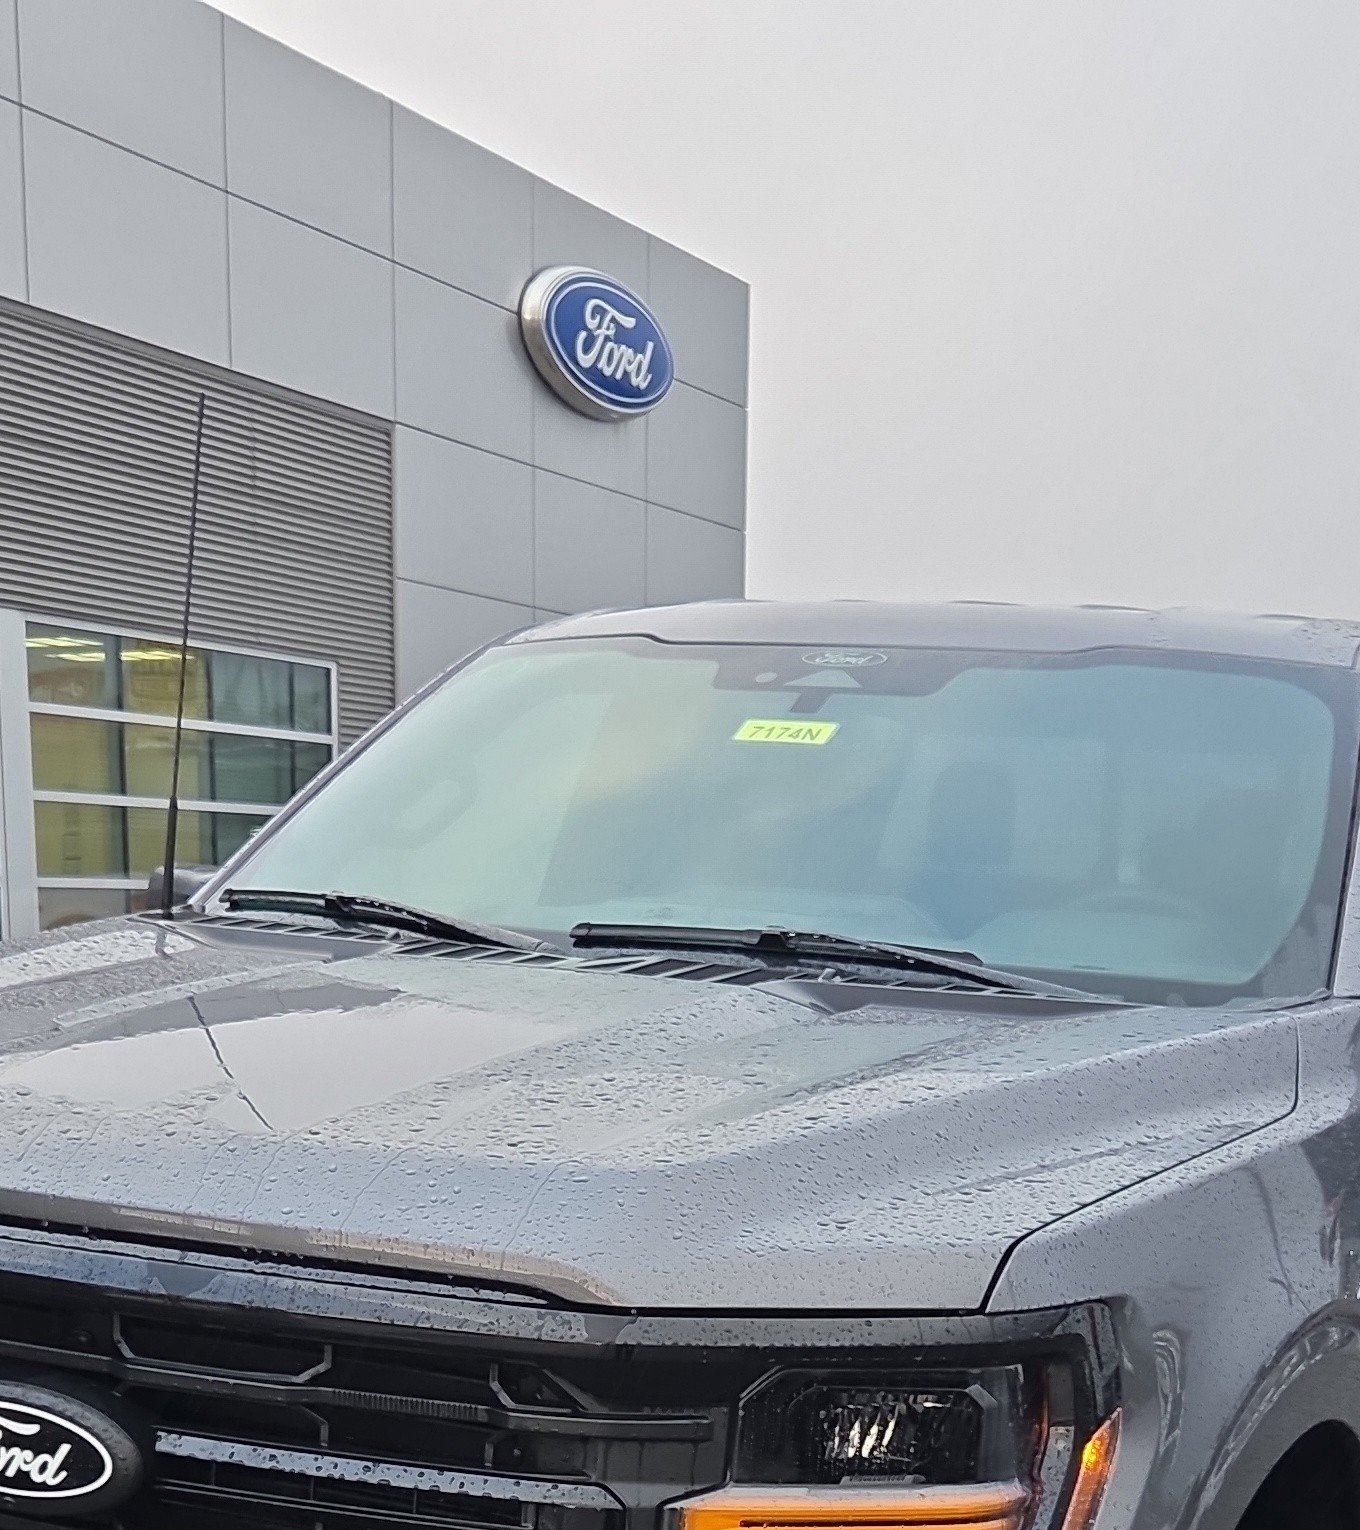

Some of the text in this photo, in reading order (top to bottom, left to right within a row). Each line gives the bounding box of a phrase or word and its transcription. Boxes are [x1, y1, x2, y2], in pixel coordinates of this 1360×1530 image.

[576, 298, 654, 390] Ford
[815, 652, 873, 665] Ford
[748, 726, 822, 741] 7174N
